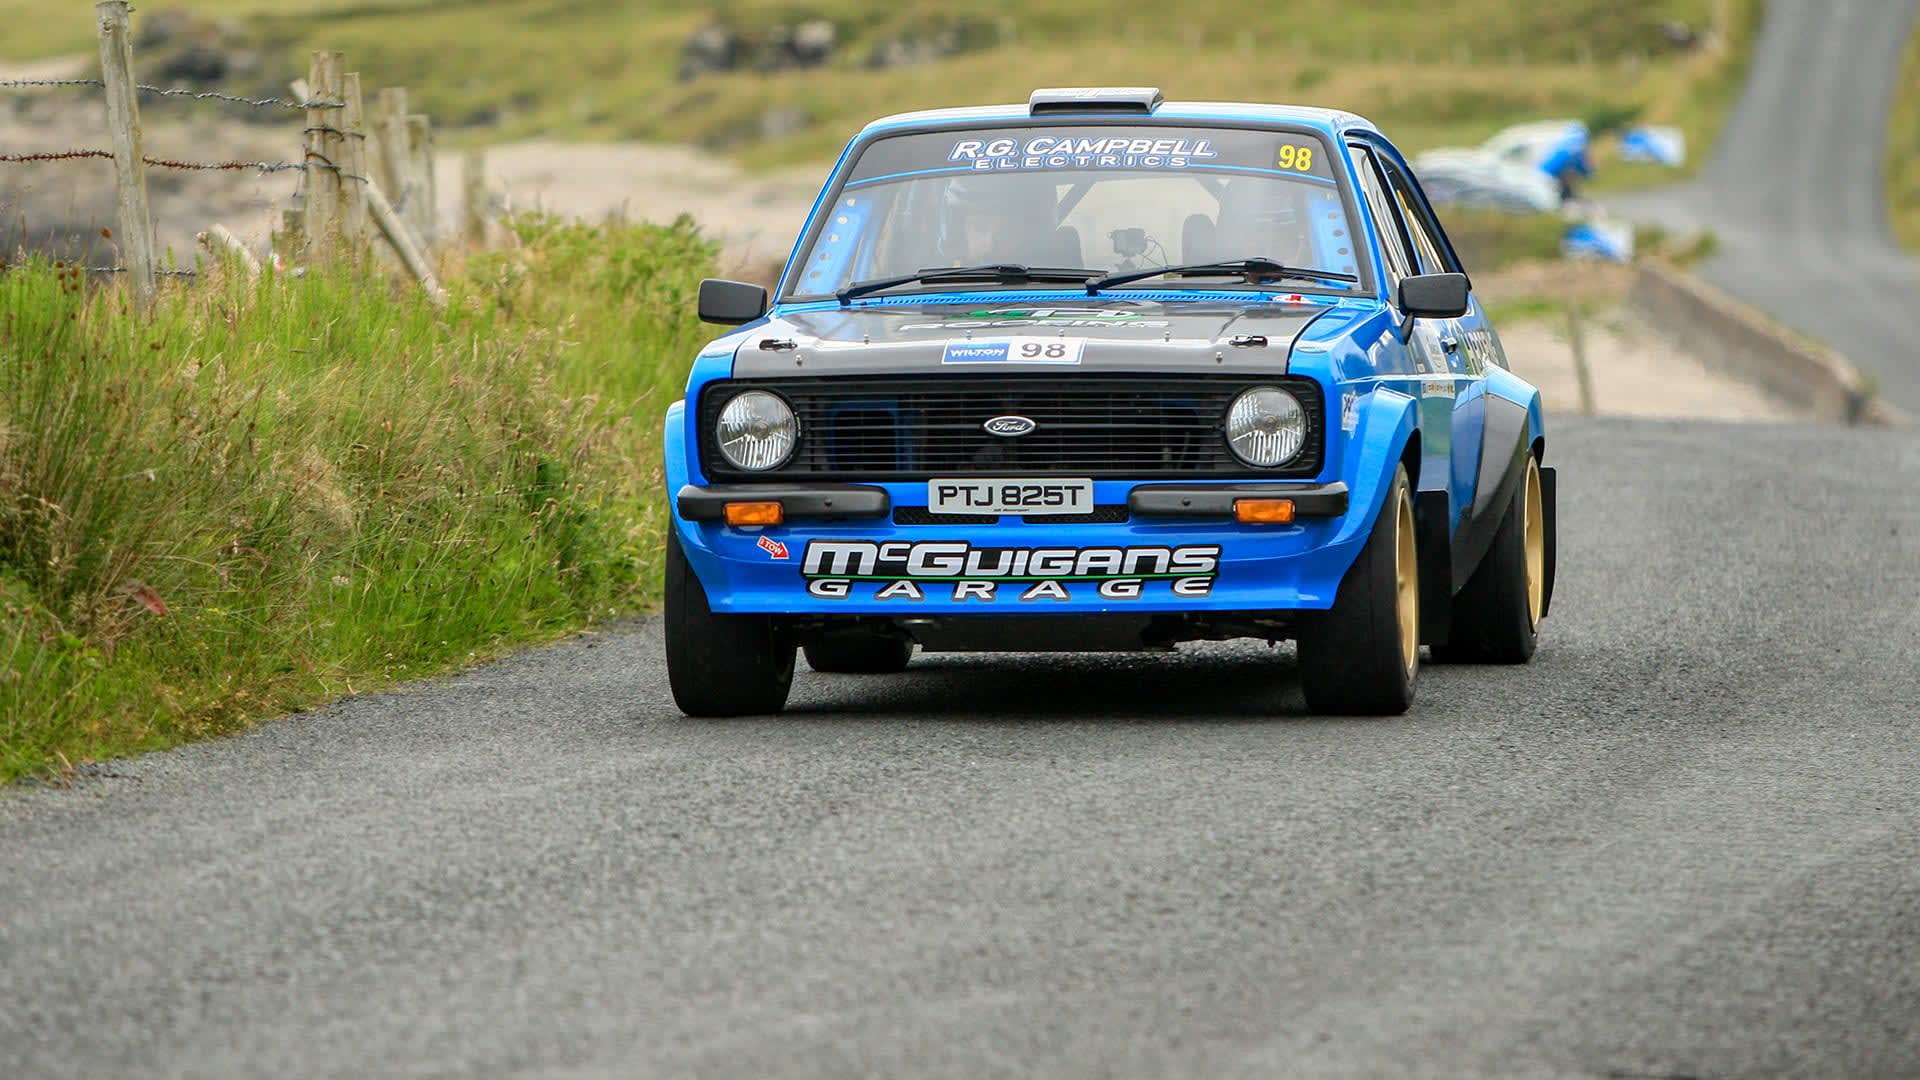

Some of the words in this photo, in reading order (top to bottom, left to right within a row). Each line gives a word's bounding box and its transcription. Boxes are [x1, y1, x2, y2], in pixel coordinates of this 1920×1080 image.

[1025, 137, 1216, 158] CAMPBELL
[974, 156, 1189, 170] ELECTRICS
[1277, 144, 1312, 171] 98
[949, 348, 1005, 358] WILTON
[1020, 343, 1067, 358] 98
[992, 420, 1025, 432] Ford
[937, 485, 994, 506] PTJ
[1001, 485, 1085, 506] 825T
[765, 540, 785, 555] TOW
[808, 577, 1213, 599] GARAGE
